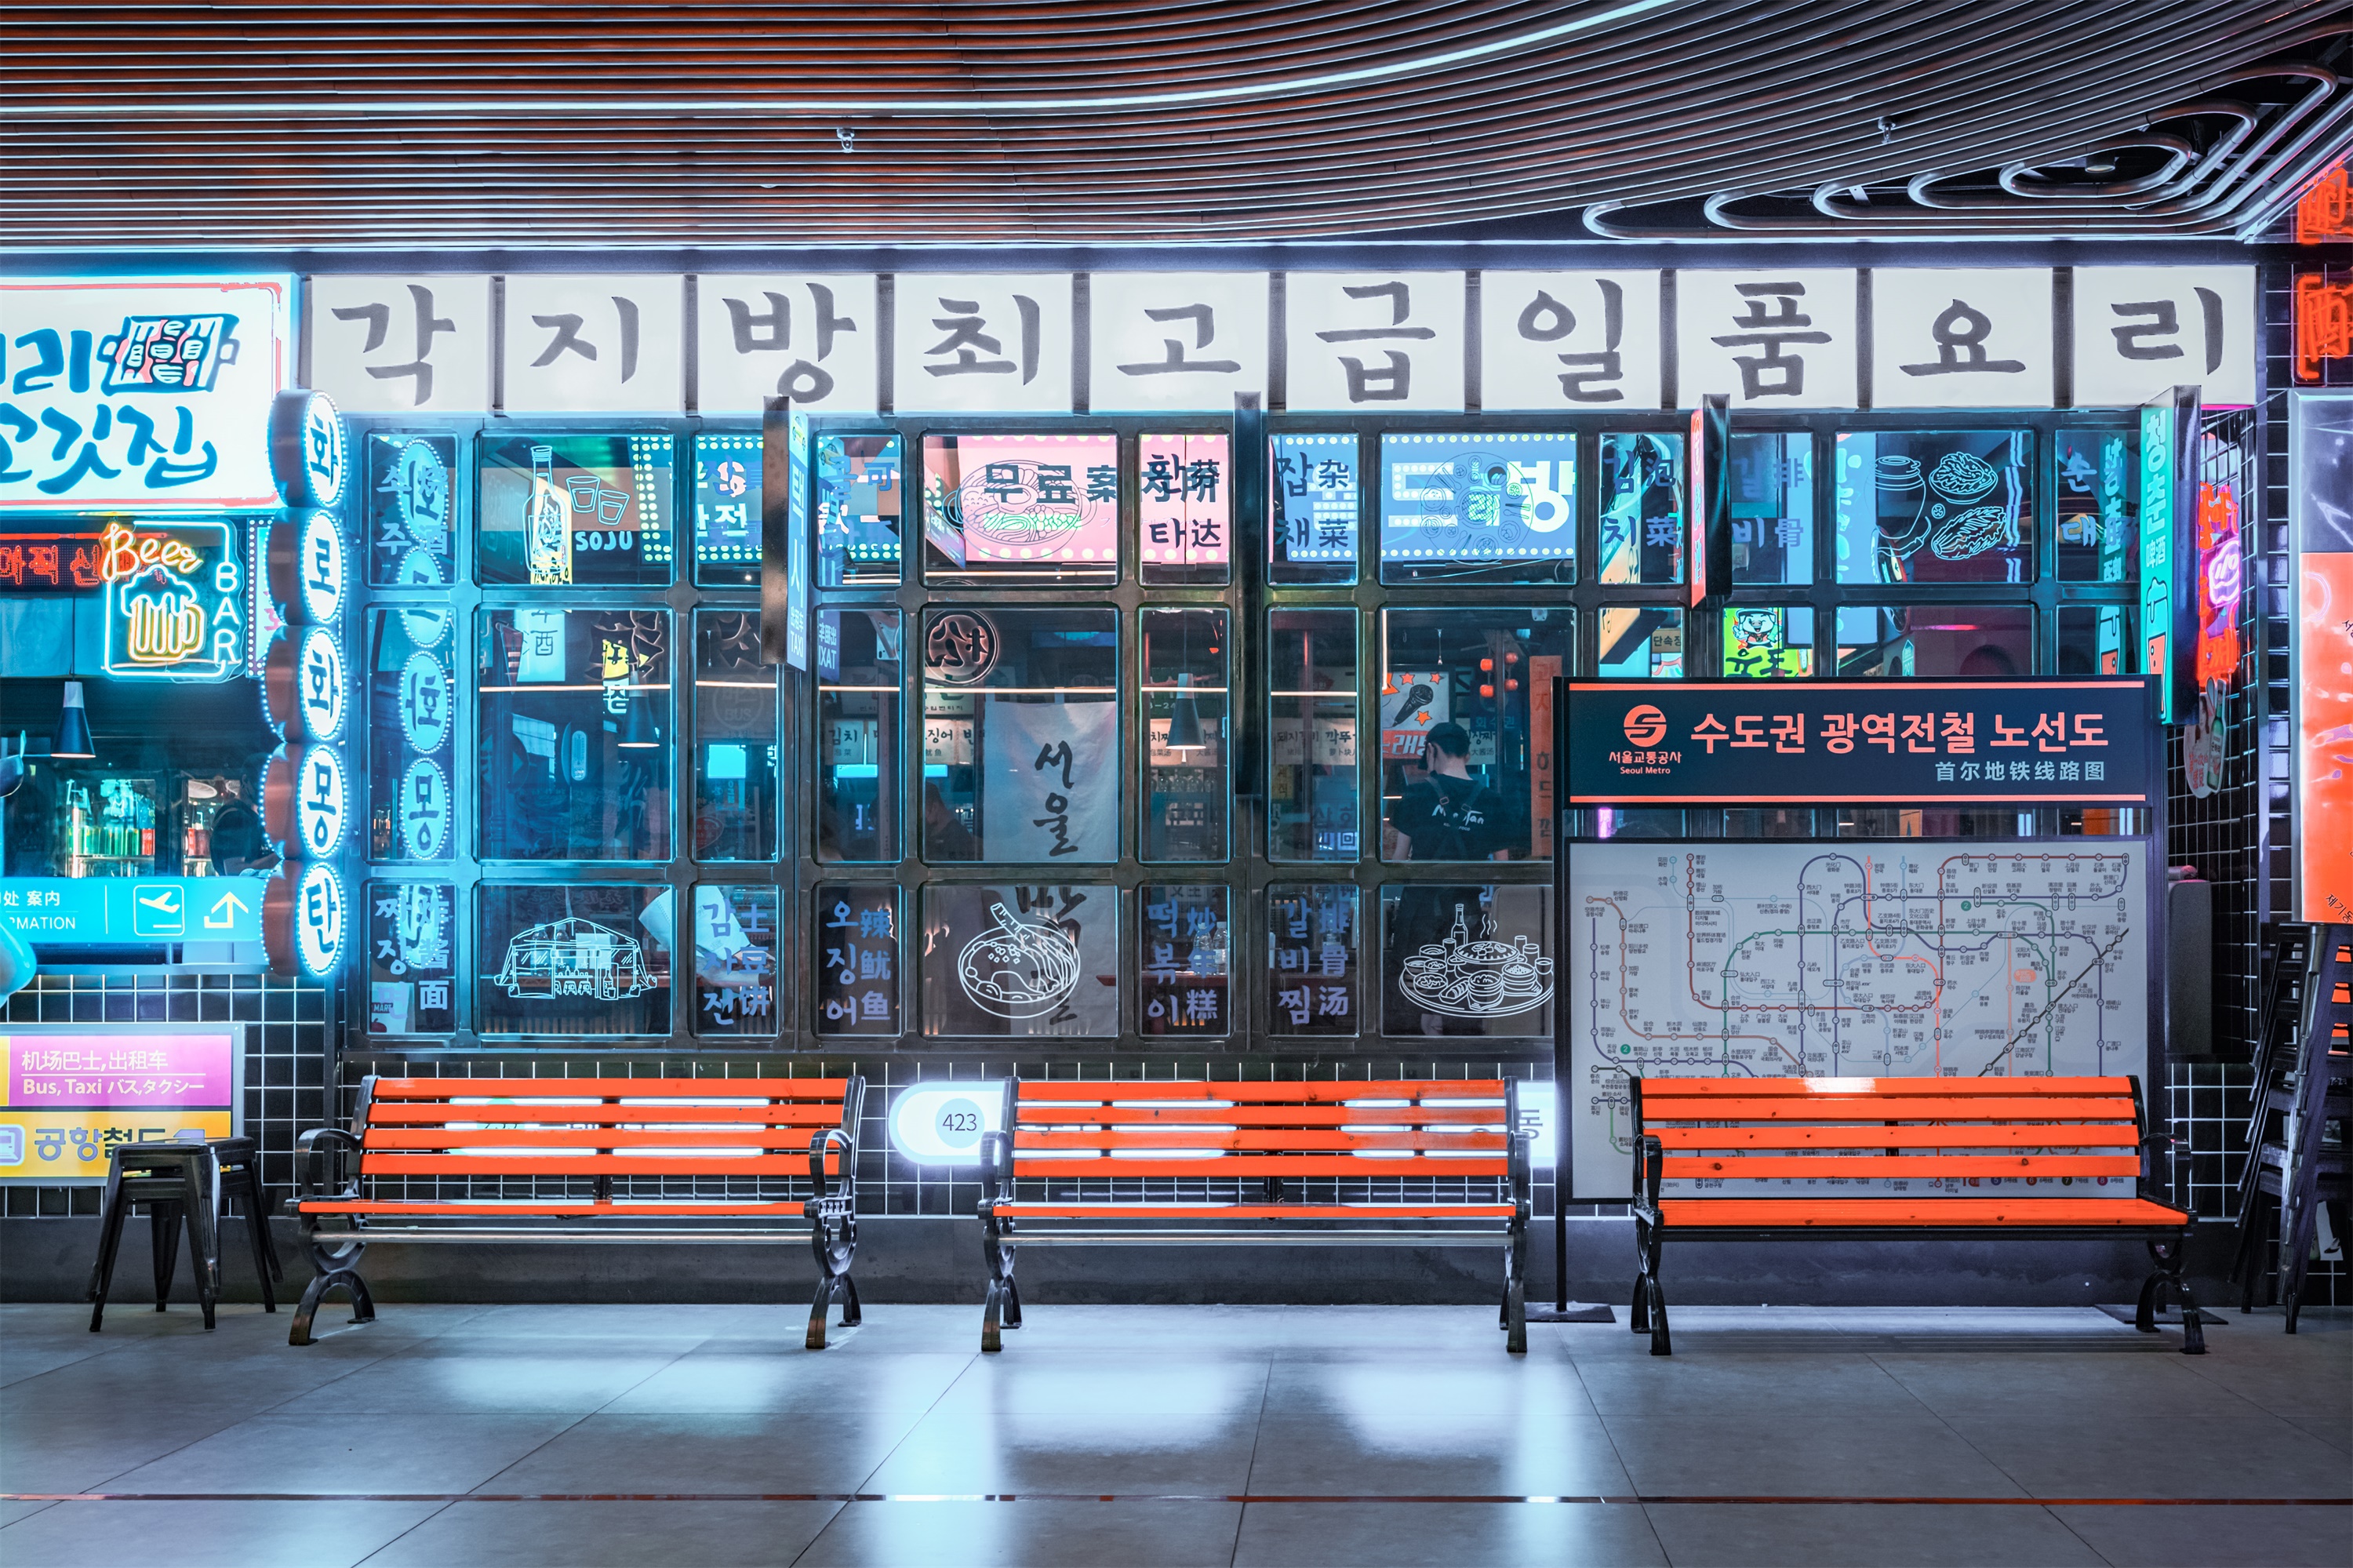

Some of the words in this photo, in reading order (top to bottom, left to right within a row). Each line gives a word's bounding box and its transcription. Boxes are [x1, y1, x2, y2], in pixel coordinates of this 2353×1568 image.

[376, 464, 412, 555] 소주
[575, 529, 633, 551] SOJU
[1147, 453, 1188, 549] 환타
[1189, 458, 1221, 548] 芬达
[1274, 451, 1314, 548] 잡채
[1318, 459, 1350, 549] 杂菜
[1602, 449, 1640, 548] 김치
[1646, 458, 1677, 548] 泡菜
[1773, 457, 1812, 548] 排骨
[2061, 452, 2098, 548] 순대
[102, 522, 204, 574] Beer
[213, 562, 241, 664] BAR
[790, 631, 805, 659] TAXI
[1609, 751, 1683, 765] 서울교통공사
[1620, 766, 1642, 775] Seoul
[1645, 766, 1671, 775] Metro
[1691, 713, 1806, 754] 수도권
[1820, 713, 1977, 755] 광역전철
[1991, 713, 2110, 753] 노선도
[1935, 761, 2107, 782] 首尔地铁线路图
[27, 890, 60, 907] 案内
[702, 898, 735, 1026] 감자전
[738, 903, 771, 1017] 土豆饼
[825, 900, 859, 1026] 오징어
[860, 900, 892, 1020] 辣鱿鱼
[1185, 906, 1218, 1020] 炒年糕
[1278, 896, 1313, 1026] 갈비찜
[1318, 902, 1350, 1017] 排骨汤
[23, 1079, 61, 1097] Bus,
[64, 1079, 102, 1095] Taxi
[941, 1111, 977, 1132] 423
